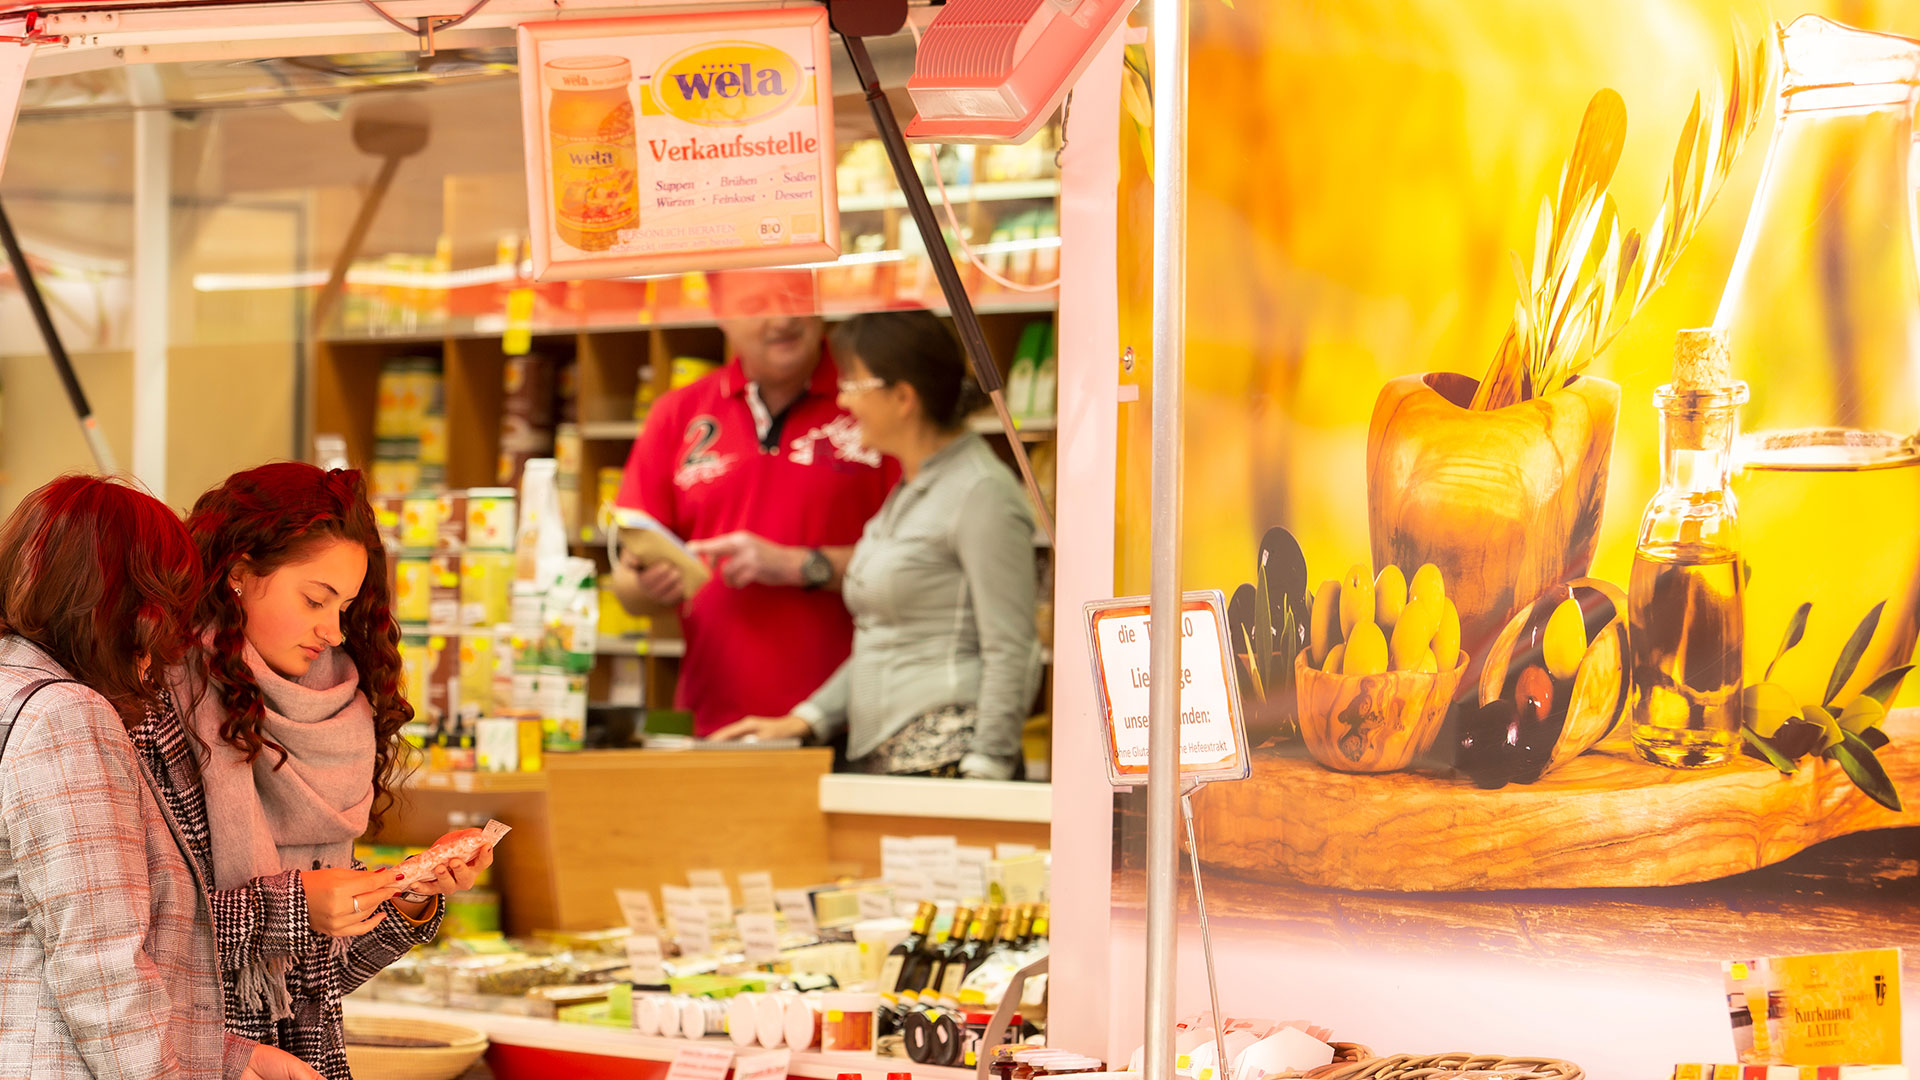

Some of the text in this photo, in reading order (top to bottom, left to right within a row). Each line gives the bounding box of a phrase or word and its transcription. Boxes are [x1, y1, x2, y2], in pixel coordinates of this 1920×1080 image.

[648, 131, 818, 163] Verkaufsstelle
[655, 171, 817, 192] Suppen Brühen Soßen
[712, 193, 756, 205] Feinkost
[775, 189, 813, 201] Dessert
[688, 223, 736, 236] BERATEN
[683, 413, 722, 466] 2
[1118, 625, 1136, 644] die
[1180, 706, 1212, 725] nden:
[1188, 740, 1228, 754] Hefeextrakt
[1794, 1006, 1851, 1024] Kurkuma
[1807, 1023, 1839, 1038] LATTE
